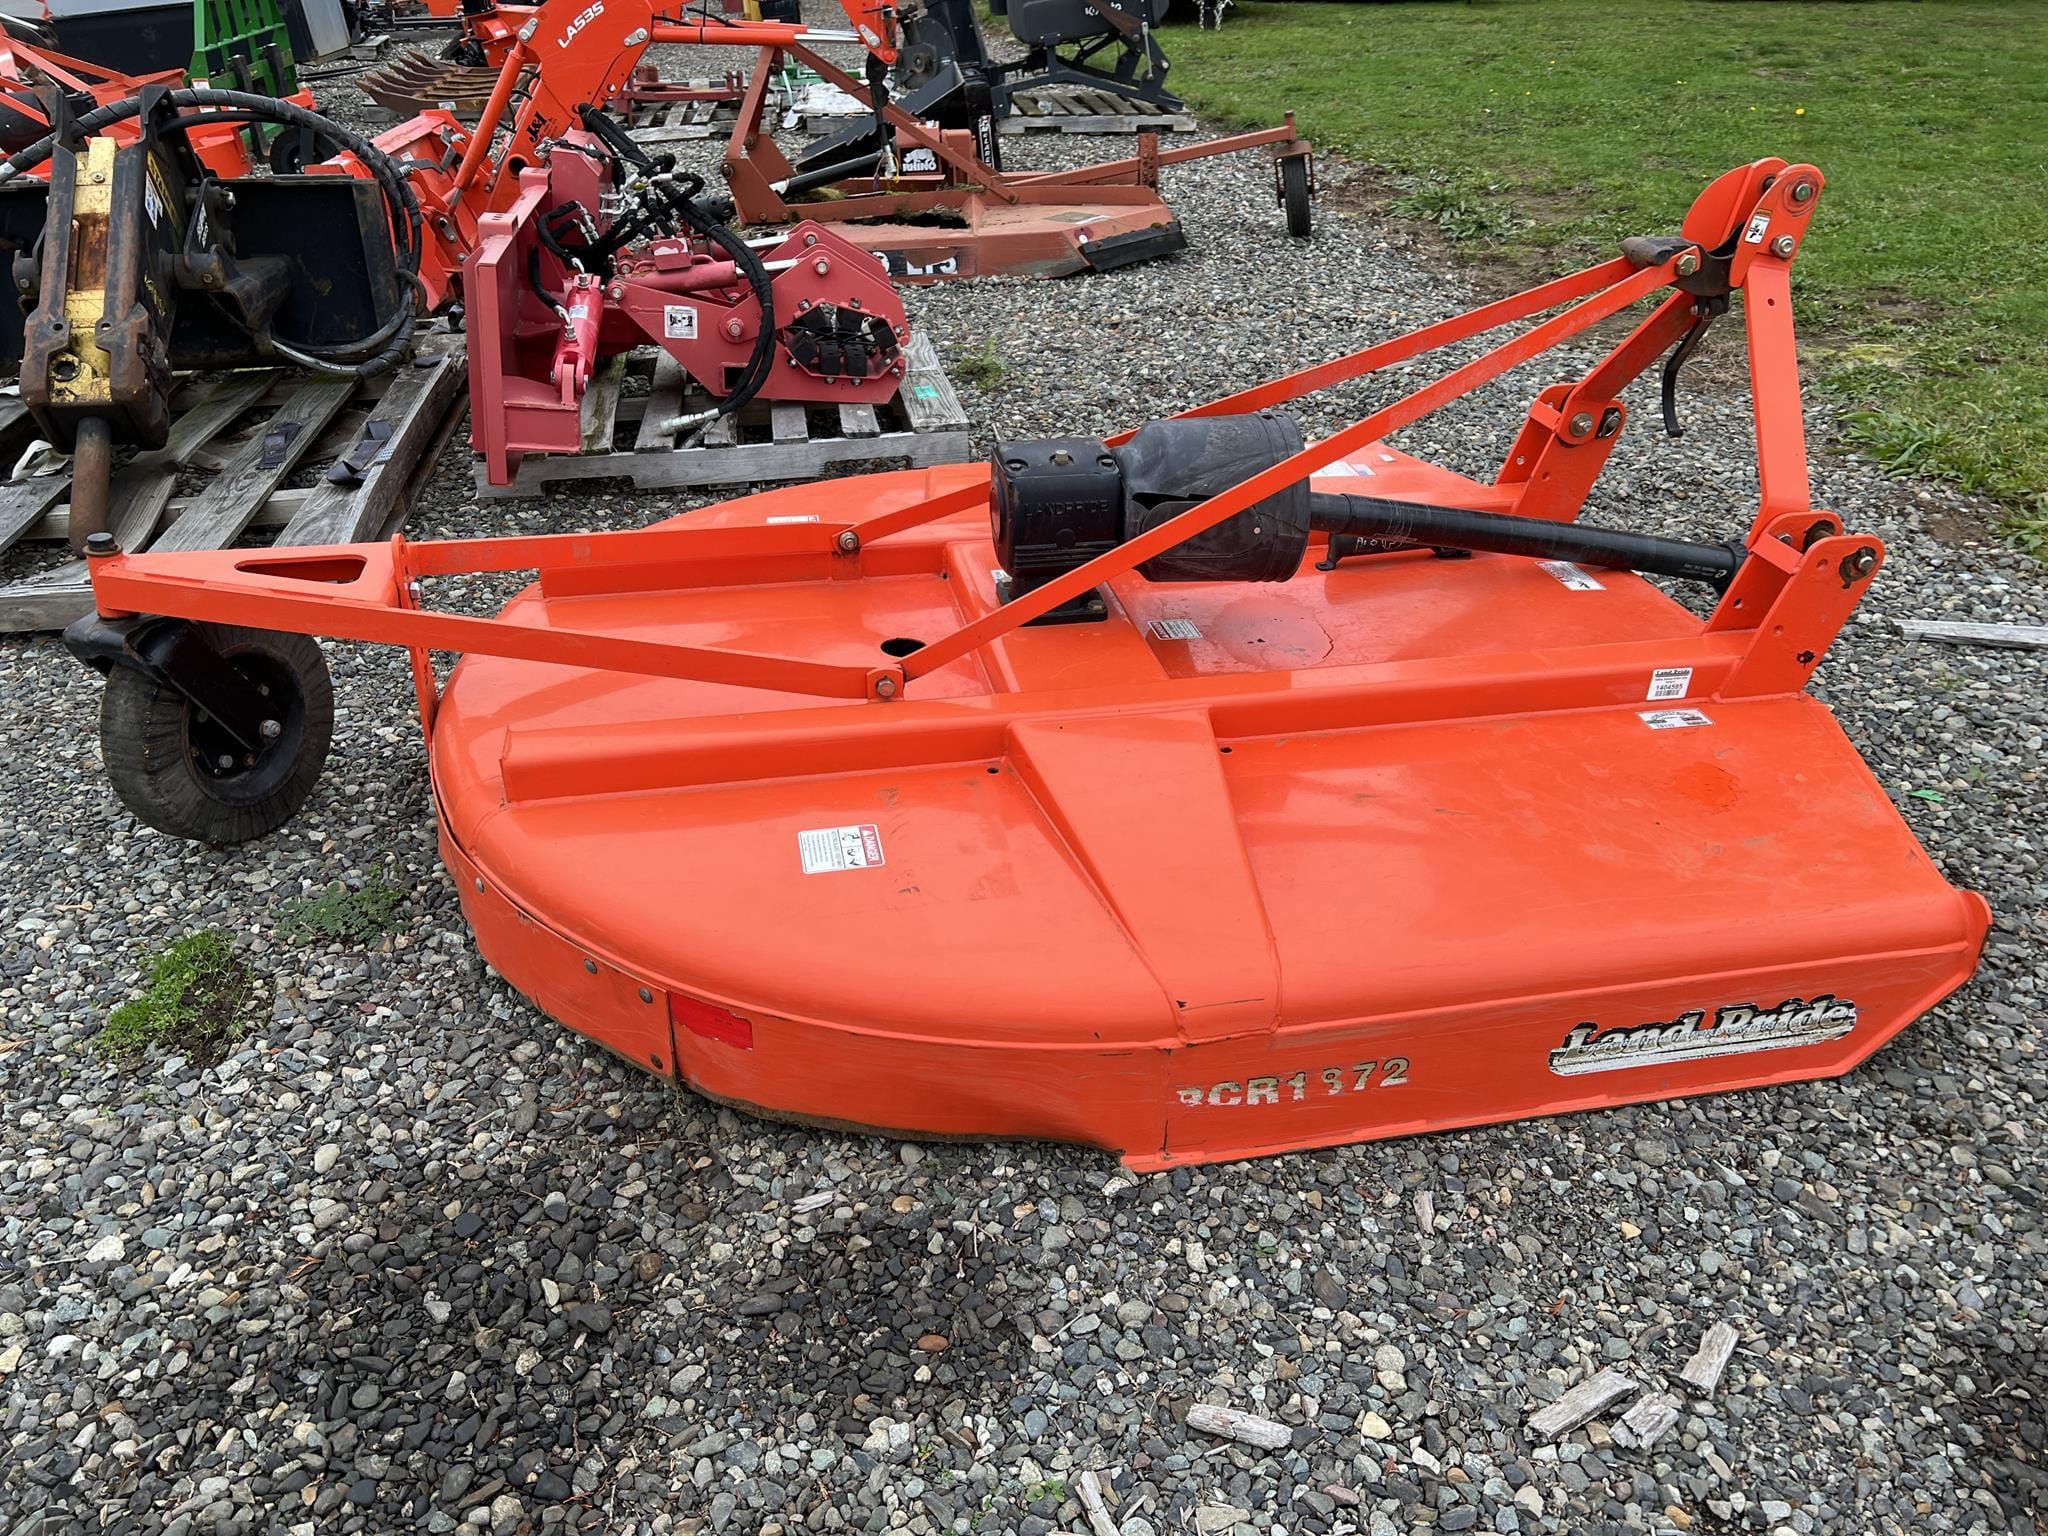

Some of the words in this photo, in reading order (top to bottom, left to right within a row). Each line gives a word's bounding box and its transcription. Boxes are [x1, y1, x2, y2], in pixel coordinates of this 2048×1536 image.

[557, 1, 605, 48] LA535
[902, 161, 937, 172] RHINO
[865, 836, 880, 862] DANGER
[1559, 1009, 1704, 1061] Land
[1716, 994, 1856, 1042] Pride
